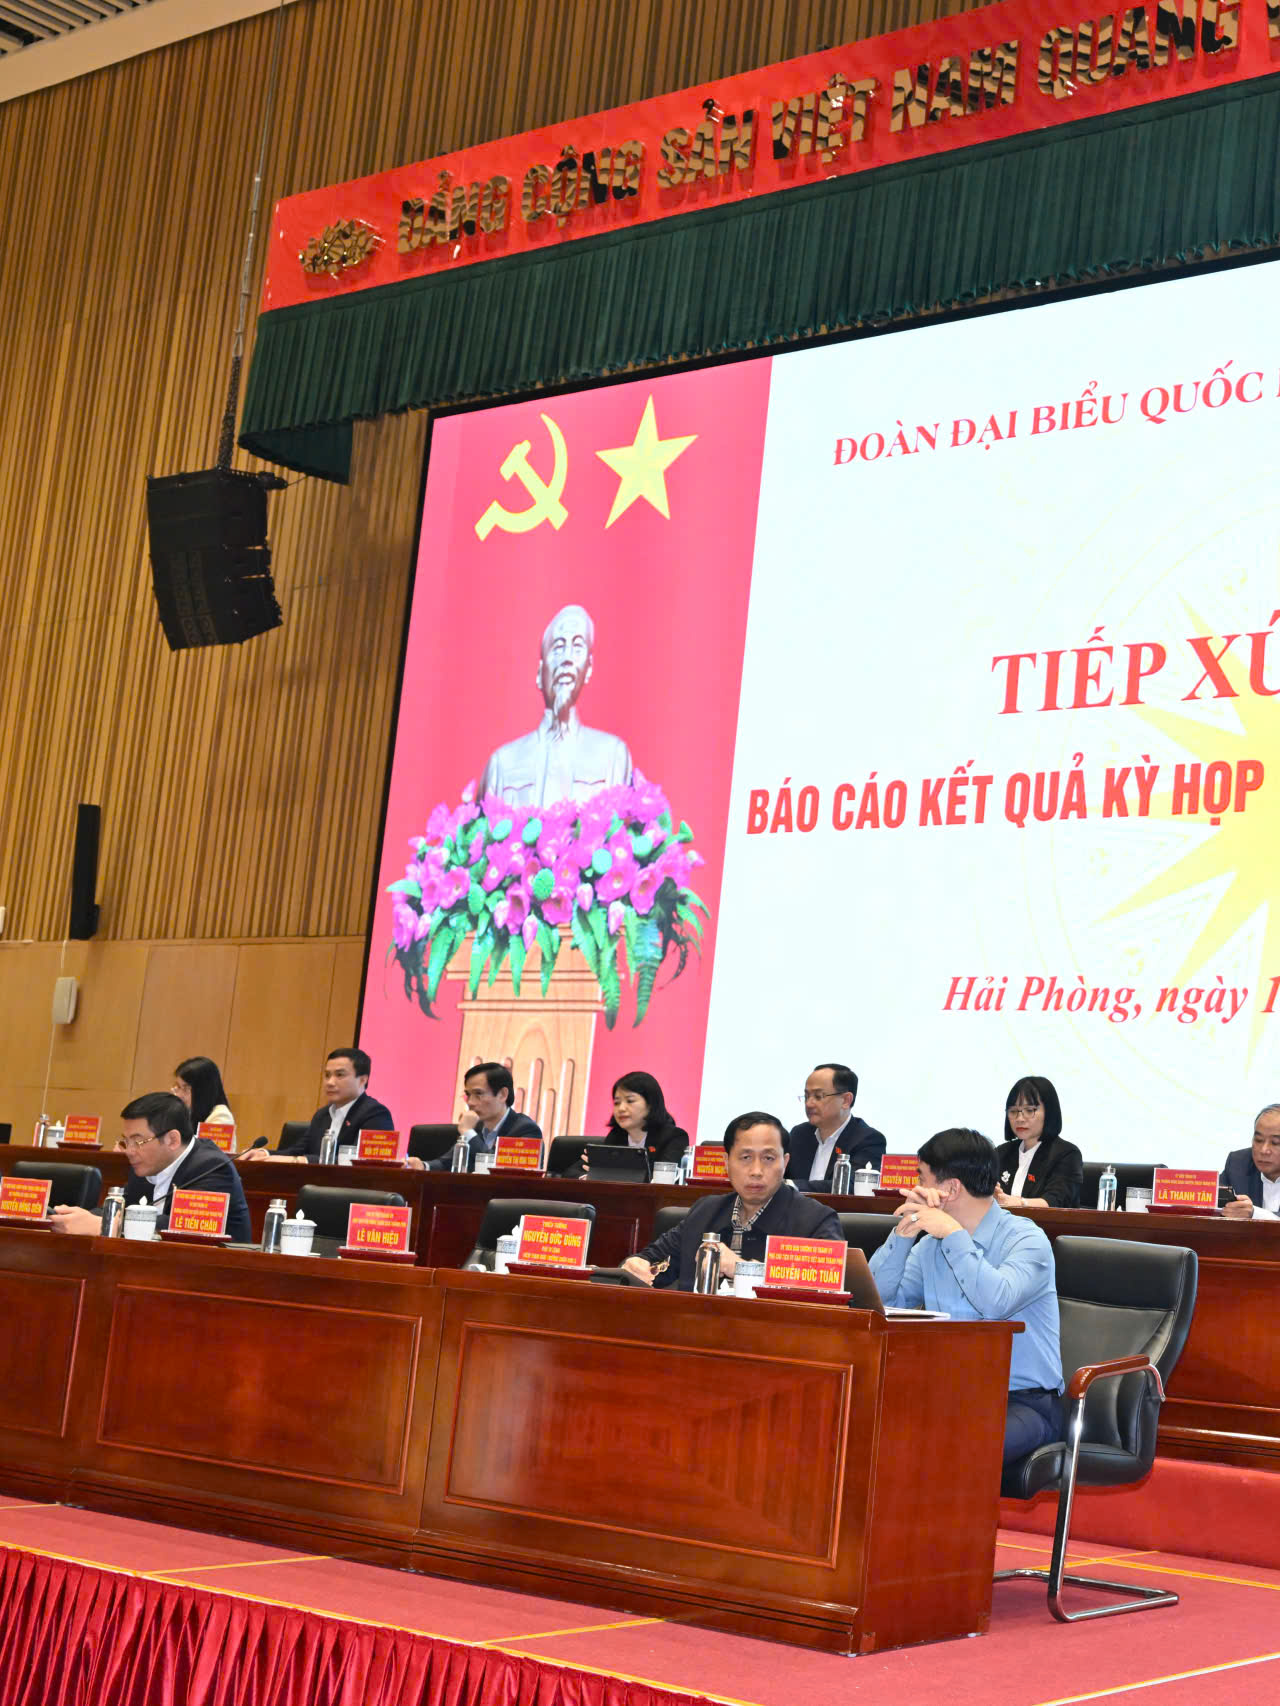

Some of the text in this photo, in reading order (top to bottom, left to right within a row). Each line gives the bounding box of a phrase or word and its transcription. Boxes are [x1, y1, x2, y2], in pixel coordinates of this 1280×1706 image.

[521, 140, 645, 232] CỘNG
[657, 99, 757, 188] SẢN
[772, 73, 880, 164] VIỆT
[890, 38, 1019, 133] NAM
[1037, 0, 1240, 98] QUANG
[834, 418, 940, 466] ĐOÀN
[951, 411, 1018, 450] ĐẠI
[1031, 381, 1128, 436] BIỂU
[1139, 359, 1265, 425] QUỐC
[991, 626, 1168, 715] TIẾP
[746, 776, 820, 835] BÁO
[831, 771, 908, 832] CÁO
[918, 759, 994, 829] KẾT
[1004, 751, 1088, 829] QUẢ
[1102, 753, 1161, 819] KỲ
[1171, 759, 1265, 827] HỌP
[942, 975, 1009, 1012] Hải
[1016, 975, 1142, 1023] Phòng,
[1155, 975, 1249, 1025] ngày
[770, 1263, 841, 1284] NGUYỄN ĐỨC TUẤN
